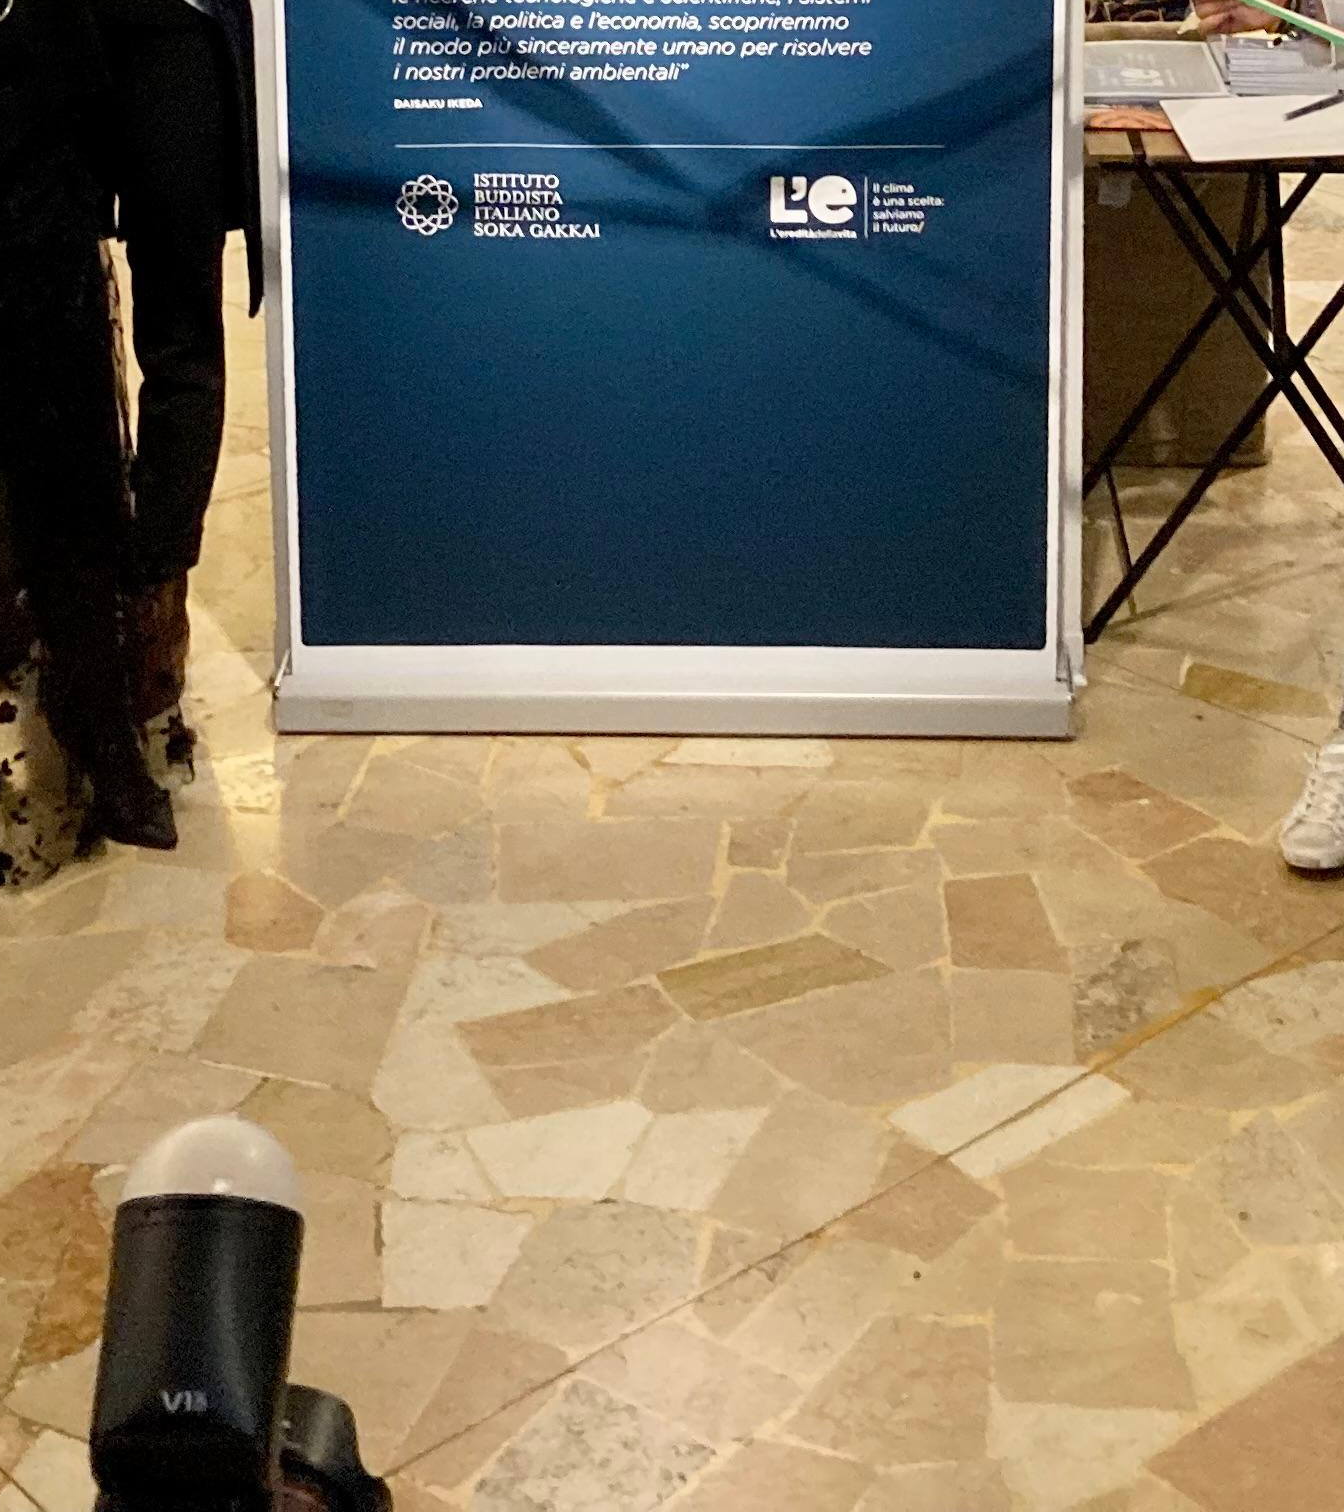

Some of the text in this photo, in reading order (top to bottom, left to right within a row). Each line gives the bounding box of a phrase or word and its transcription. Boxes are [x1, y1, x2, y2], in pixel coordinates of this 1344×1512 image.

[392, 10, 850, 33] sociali, la politica e l'economia, scopriremmo
[392, 36, 873, 59] il modo più sinceramente umano per risolvere
[392, 62, 691, 83] i nostri problemi ambientali"
[393, 97, 484, 110] DAISAKU IKEDA
[473, 172, 560, 189] ISTITUTO
[474, 189, 564, 205] BUDDISTA
[872, 196, 944, 206] è una scelta:
[475, 206, 560, 222] ITALIANO
[872, 209, 925, 221] salviamo
[473, 222, 601, 239] SOKA GAKKAI
